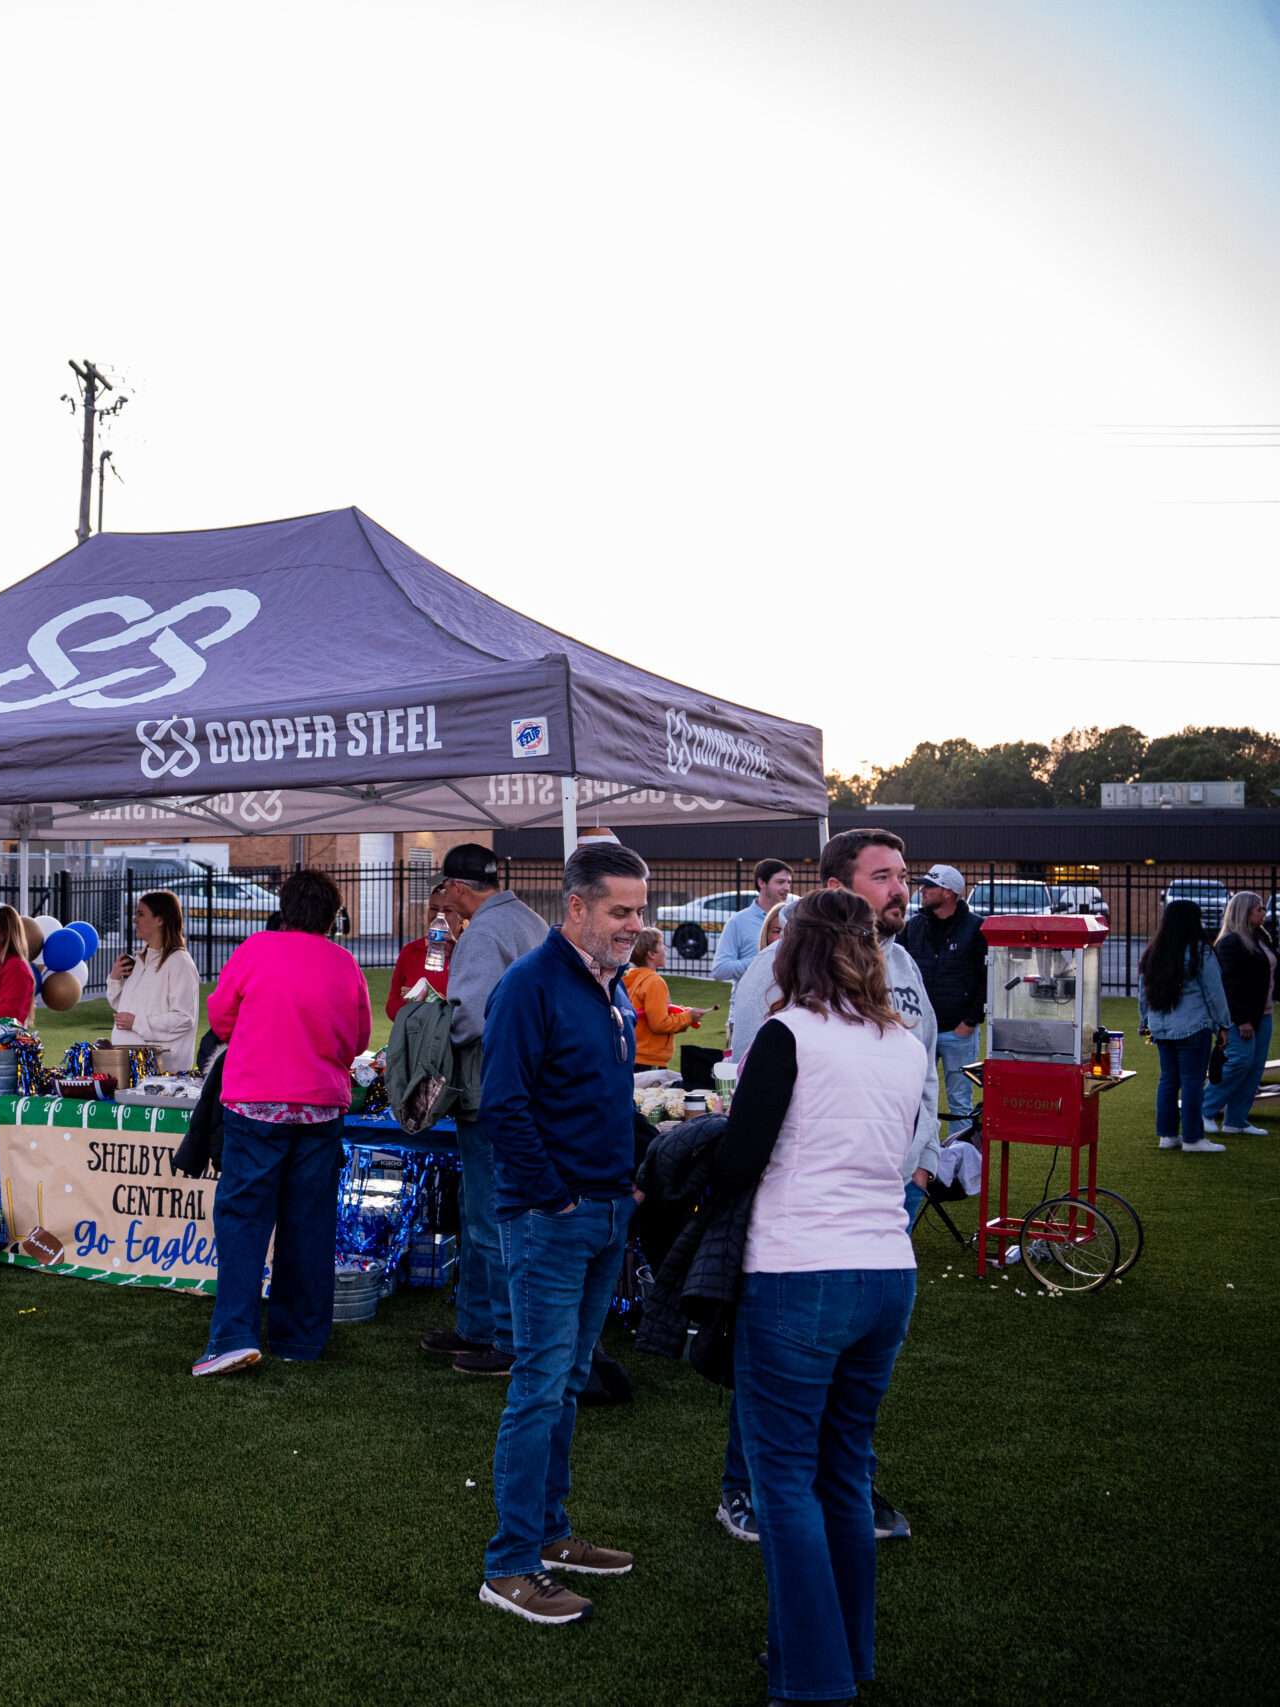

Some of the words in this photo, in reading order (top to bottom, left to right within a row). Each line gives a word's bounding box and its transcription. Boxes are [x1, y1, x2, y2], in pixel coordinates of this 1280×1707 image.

[205, 714, 336, 764] COOPER
[346, 705, 443, 757] STEEL
[1002, 1096, 1059, 1110] POPCORN
[112, 1184, 206, 1221] CENTRAL
